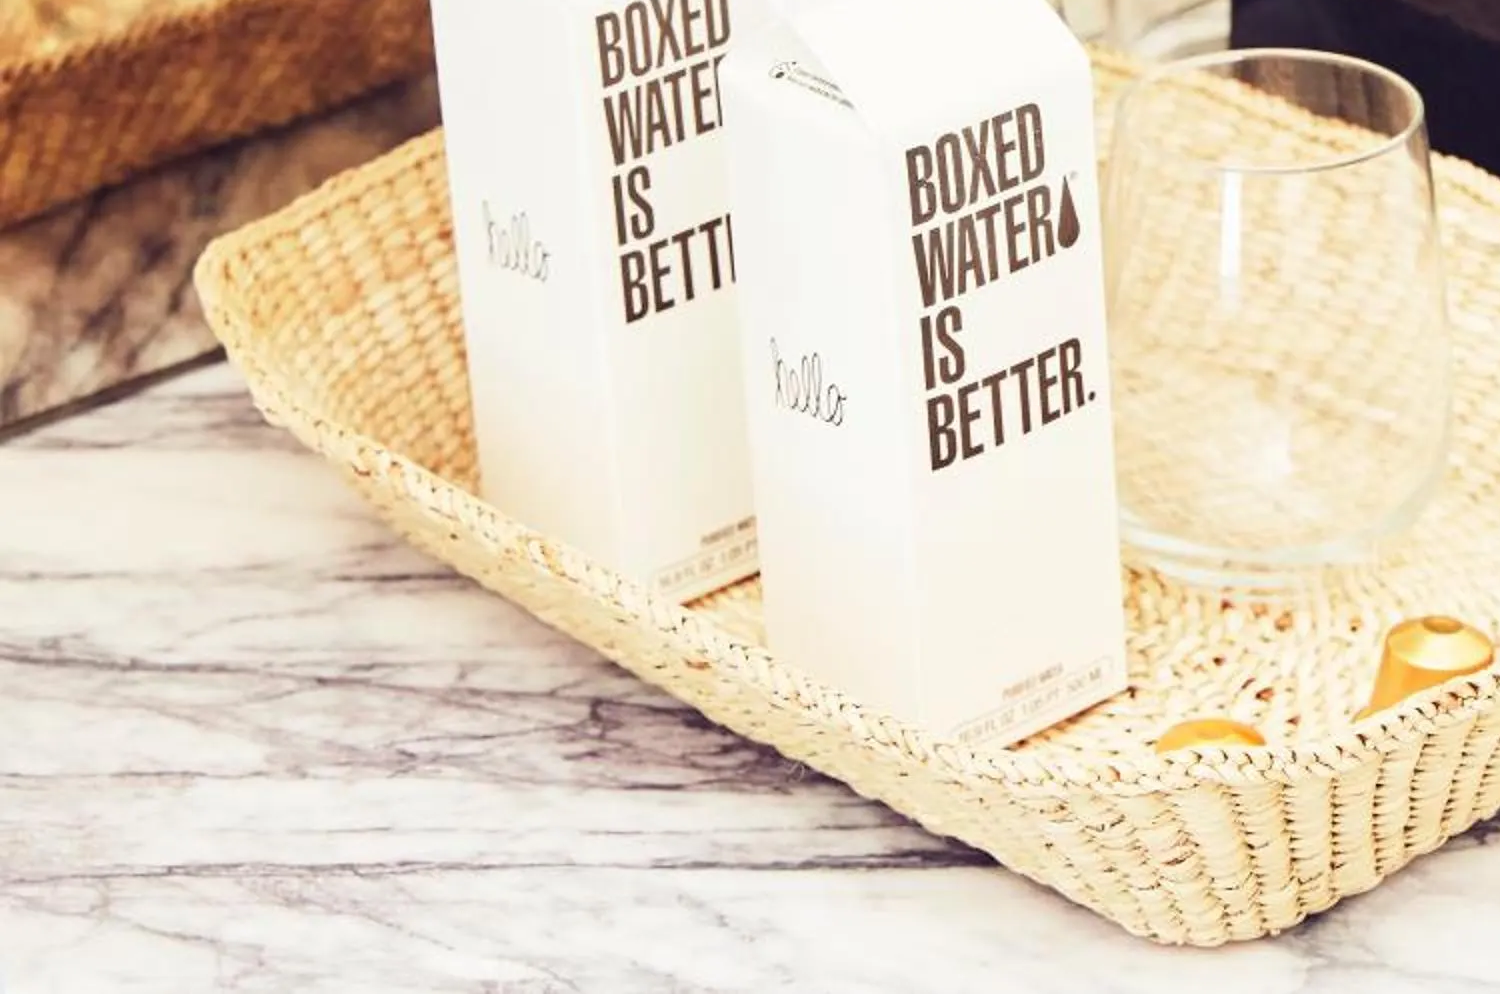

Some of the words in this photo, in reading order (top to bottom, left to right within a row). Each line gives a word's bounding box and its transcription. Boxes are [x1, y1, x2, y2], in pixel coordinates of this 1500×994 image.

[612, 165, 655, 246] IS
[905, 103, 1045, 227] BOXED
[482, 199, 550, 283] hello
[620, 213, 737, 324] BETT
[912, 186, 1056, 308] WATER
[769, 336, 847, 426] hello
[920, 305, 965, 391] IS
[927, 337, 1096, 472] BETTER.
